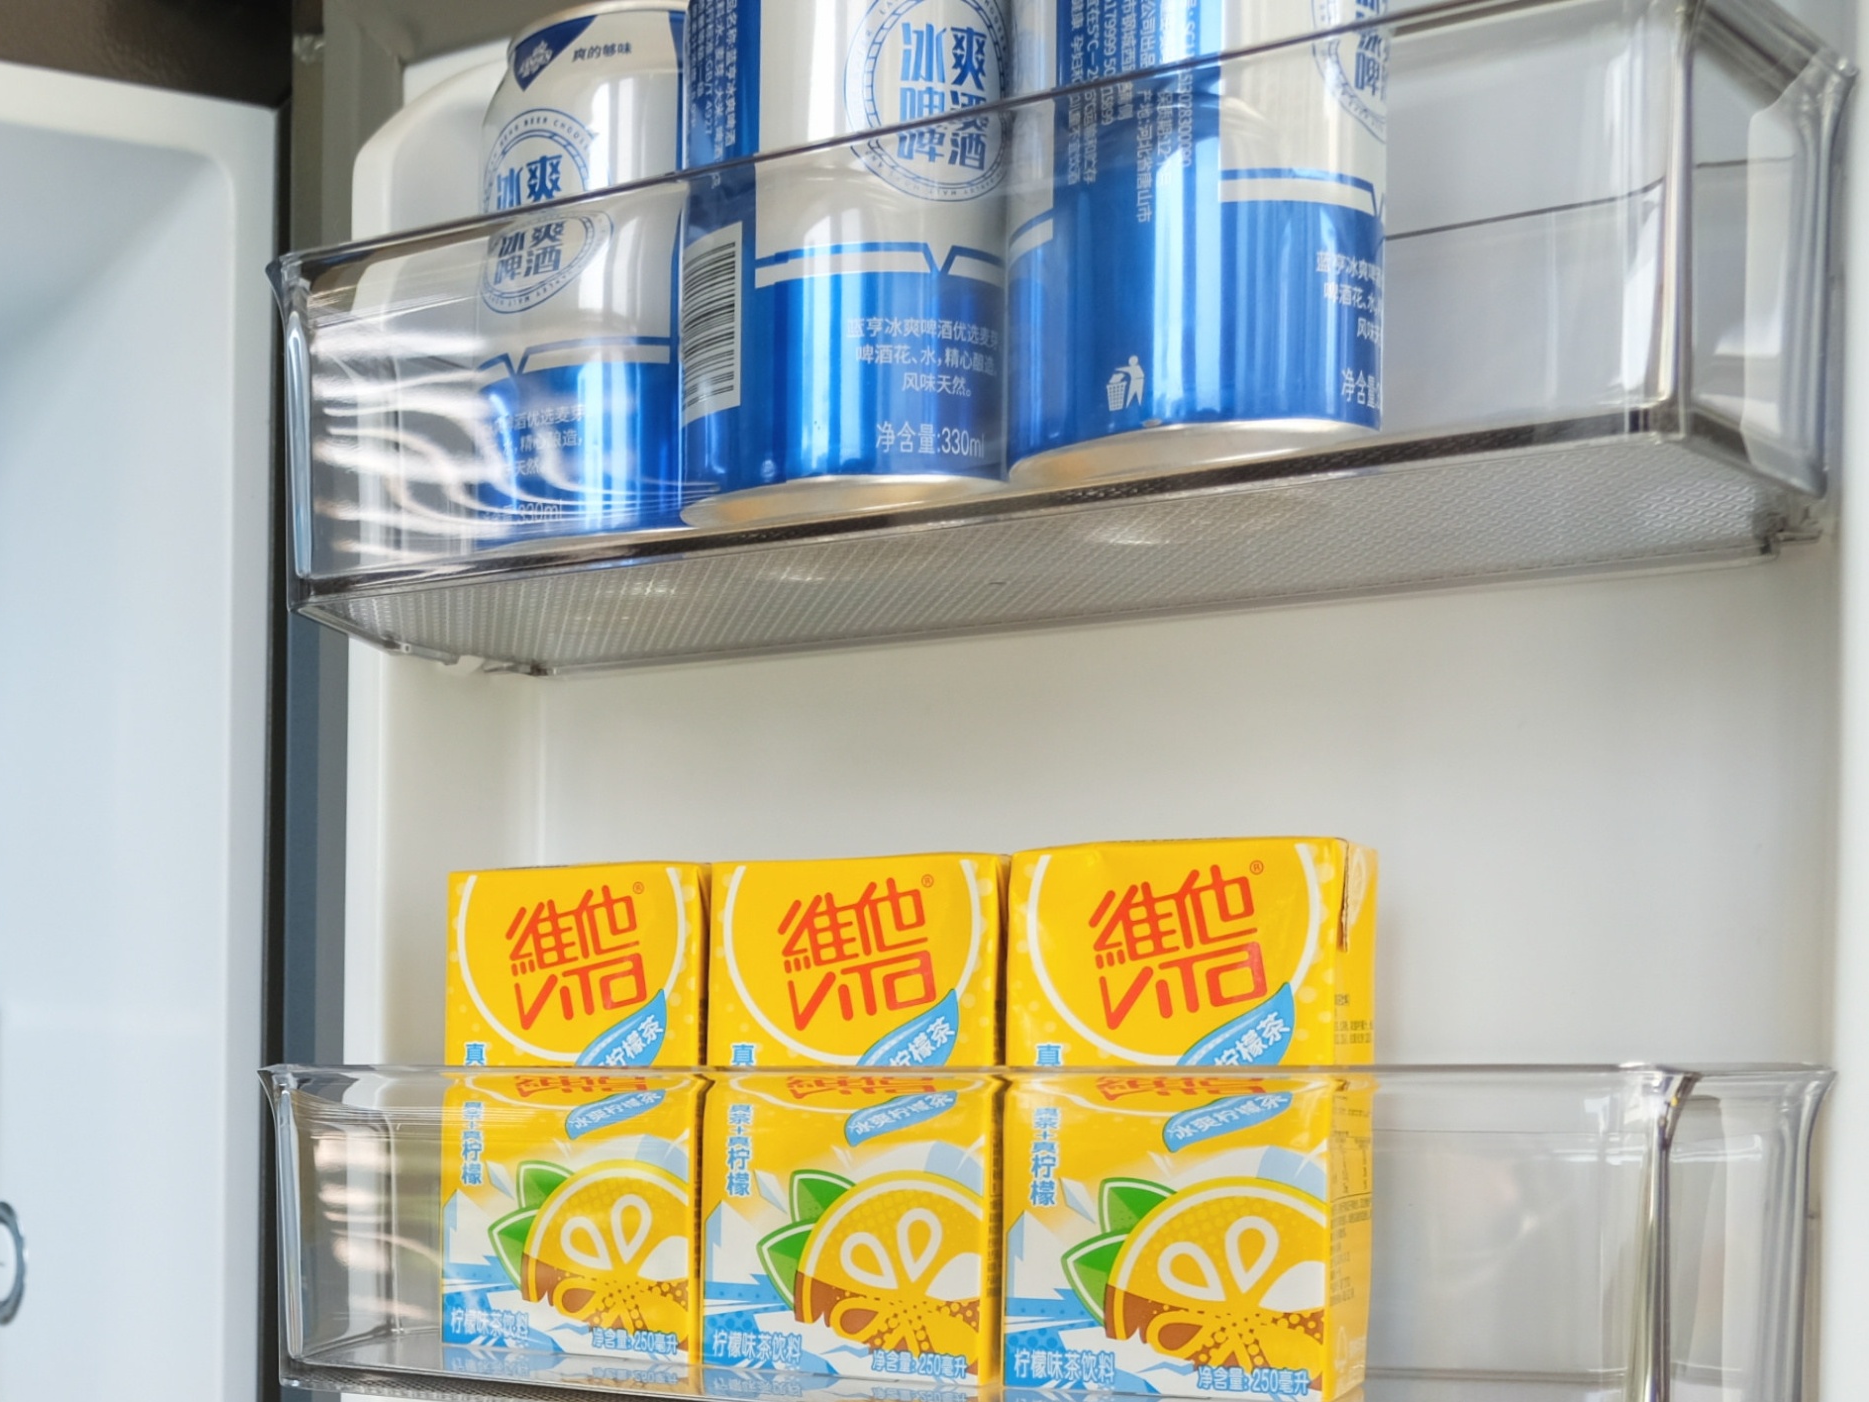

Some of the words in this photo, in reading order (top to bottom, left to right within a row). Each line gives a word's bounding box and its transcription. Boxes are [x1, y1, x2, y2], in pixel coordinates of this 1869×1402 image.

[900, 22, 988, 92] 冰爽
[493, 244, 562, 286] 啤酒
[598, 1014, 664, 1067] 柠檬茶
[449, 1307, 530, 1343] 柠檬味茶饮料
[712, 1328, 803, 1364] 柠檬味茶饮料
[1013, 1349, 1117, 1385] 柠檬味茶饮料
